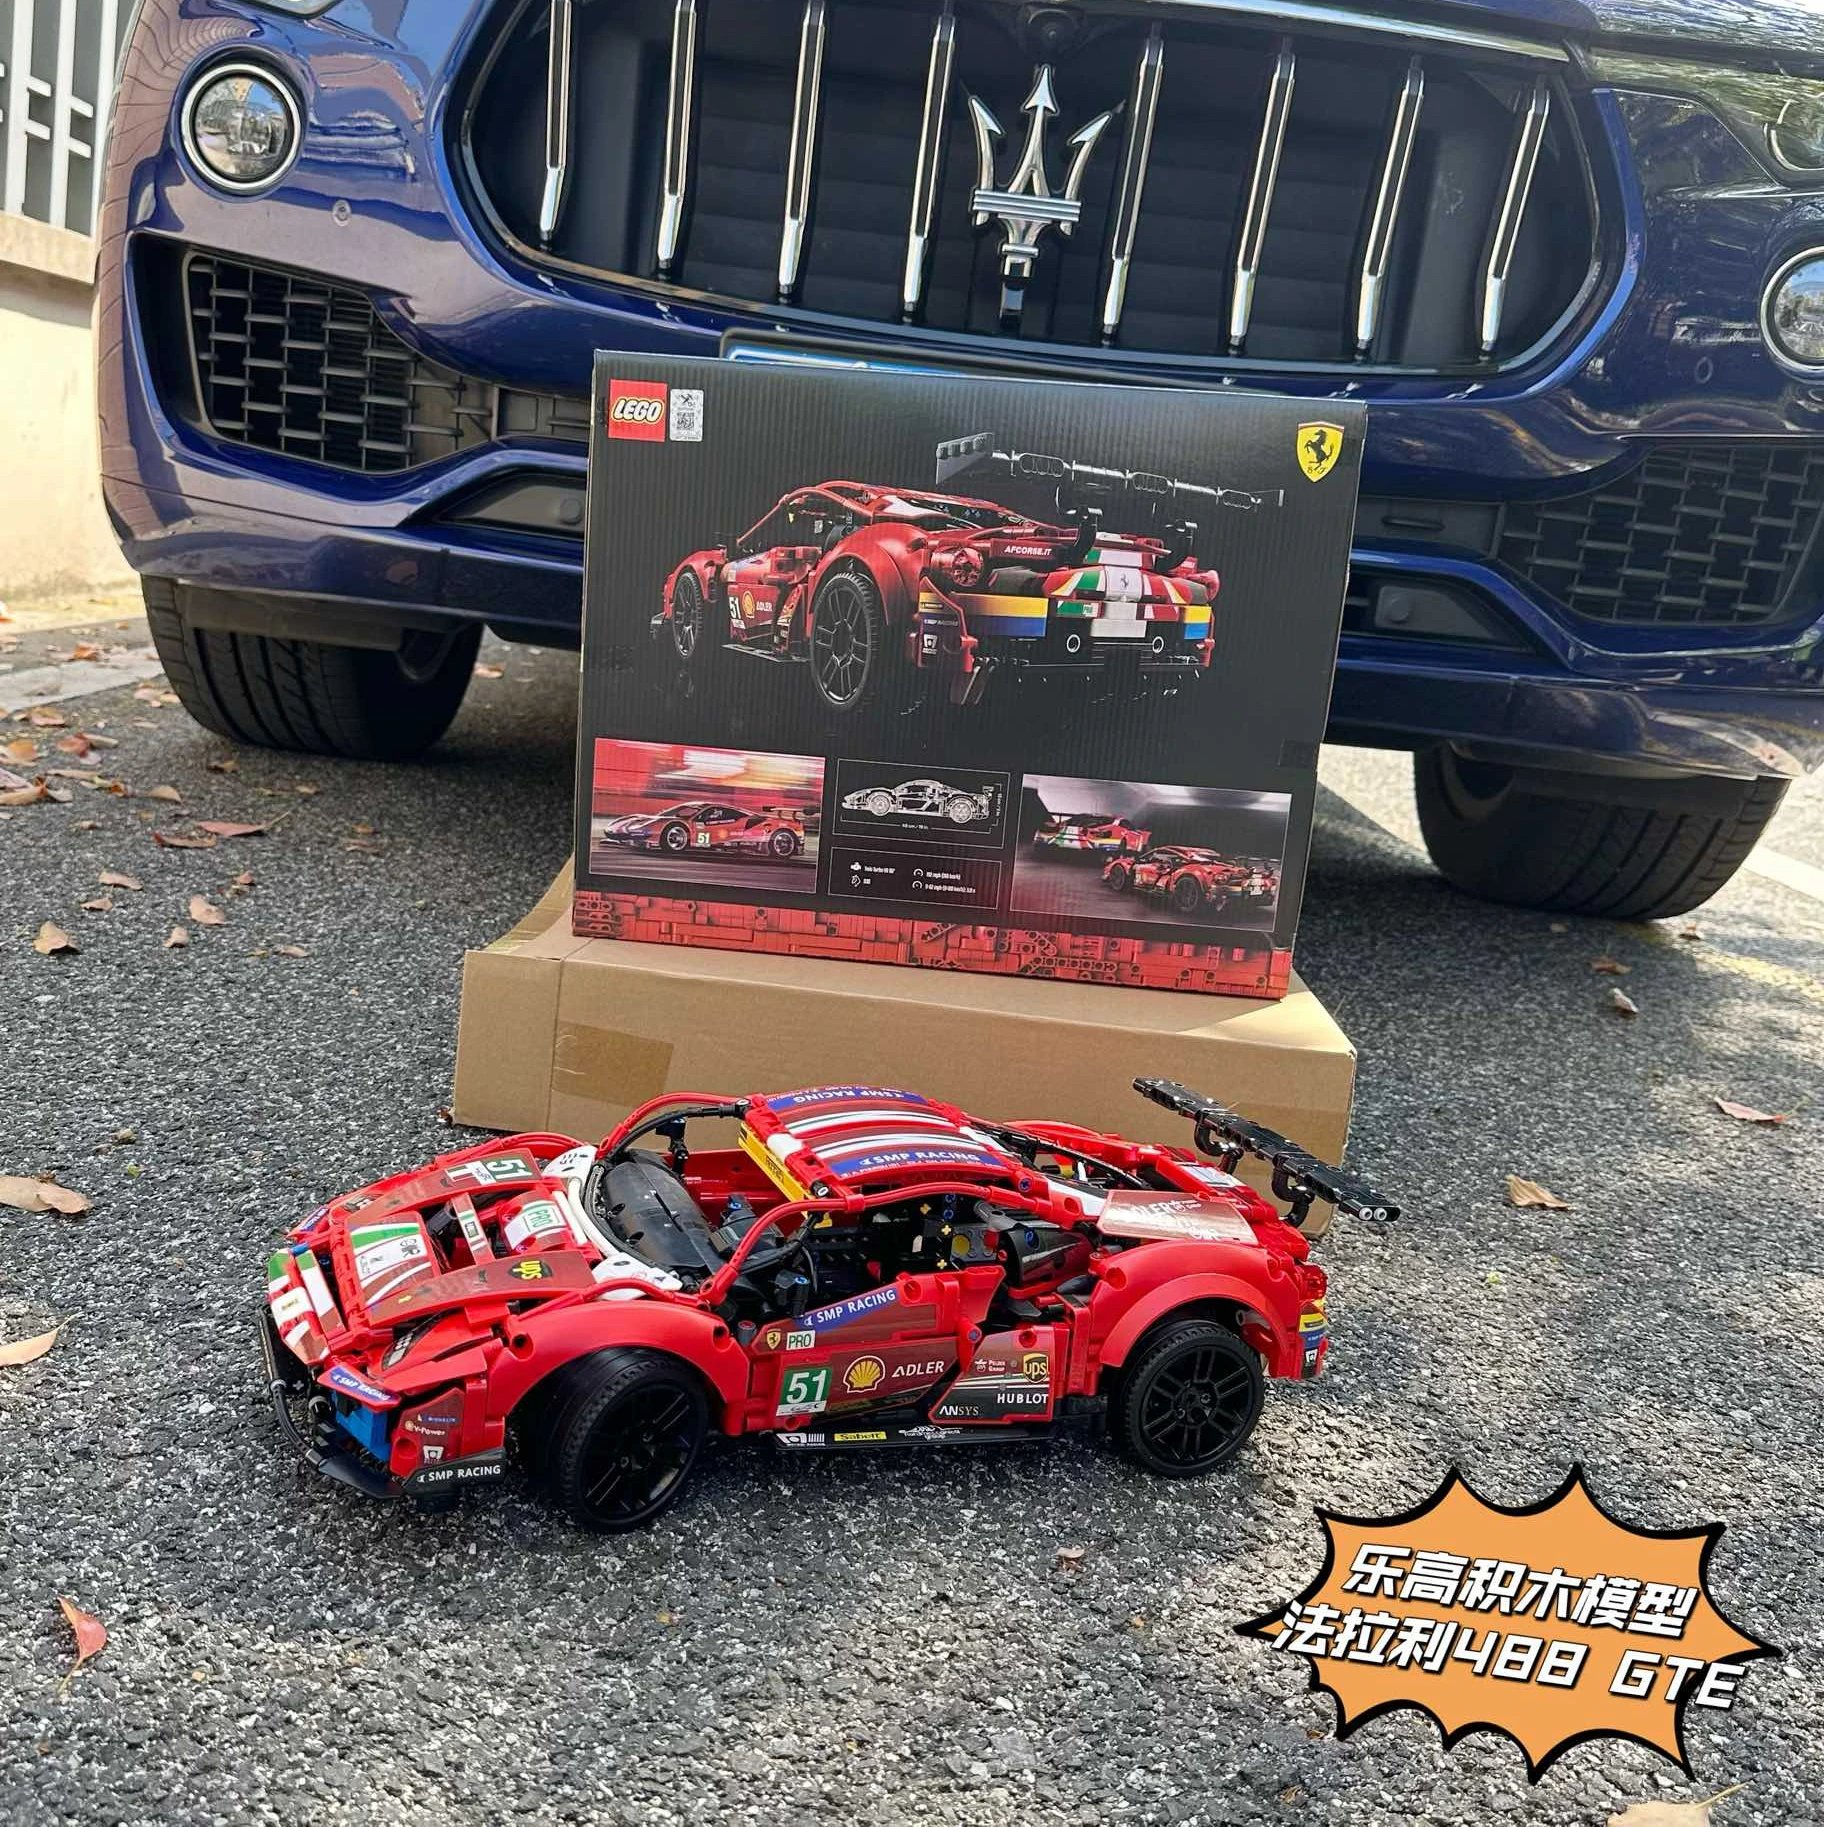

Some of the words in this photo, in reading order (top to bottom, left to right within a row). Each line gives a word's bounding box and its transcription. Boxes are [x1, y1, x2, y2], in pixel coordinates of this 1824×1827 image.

[612, 397, 663, 422] LEGO
[1004, 545, 1052, 556] AFCORSE.IT
[728, 596, 742, 619] 51
[696, 832, 711, 845] 51
[793, 1088, 856, 1103] RACING
[872, 1152, 910, 1164] SMP
[913, 1150, 981, 1161] RACING
[486, 1159, 533, 1180] 51
[528, 1209, 553, 1228] PRO
[512, 1260, 542, 1281] ups
[817, 1306, 843, 1324] SMP
[847, 1289, 896, 1314] RACING
[788, 1333, 812, 1349] PRO
[891, 1360, 945, 1378] ADLER
[1025, 1361, 1047, 1379] ups
[341, 1376, 357, 1389] SMP
[358, 1383, 391, 1401] RACING
[786, 1369, 827, 1404] 51
[997, 1393, 1048, 1404] HUBLOT
[939, 1405, 980, 1416] ANSYS
[428, 1470, 453, 1482] SMP
[457, 1464, 501, 1478] RACING
